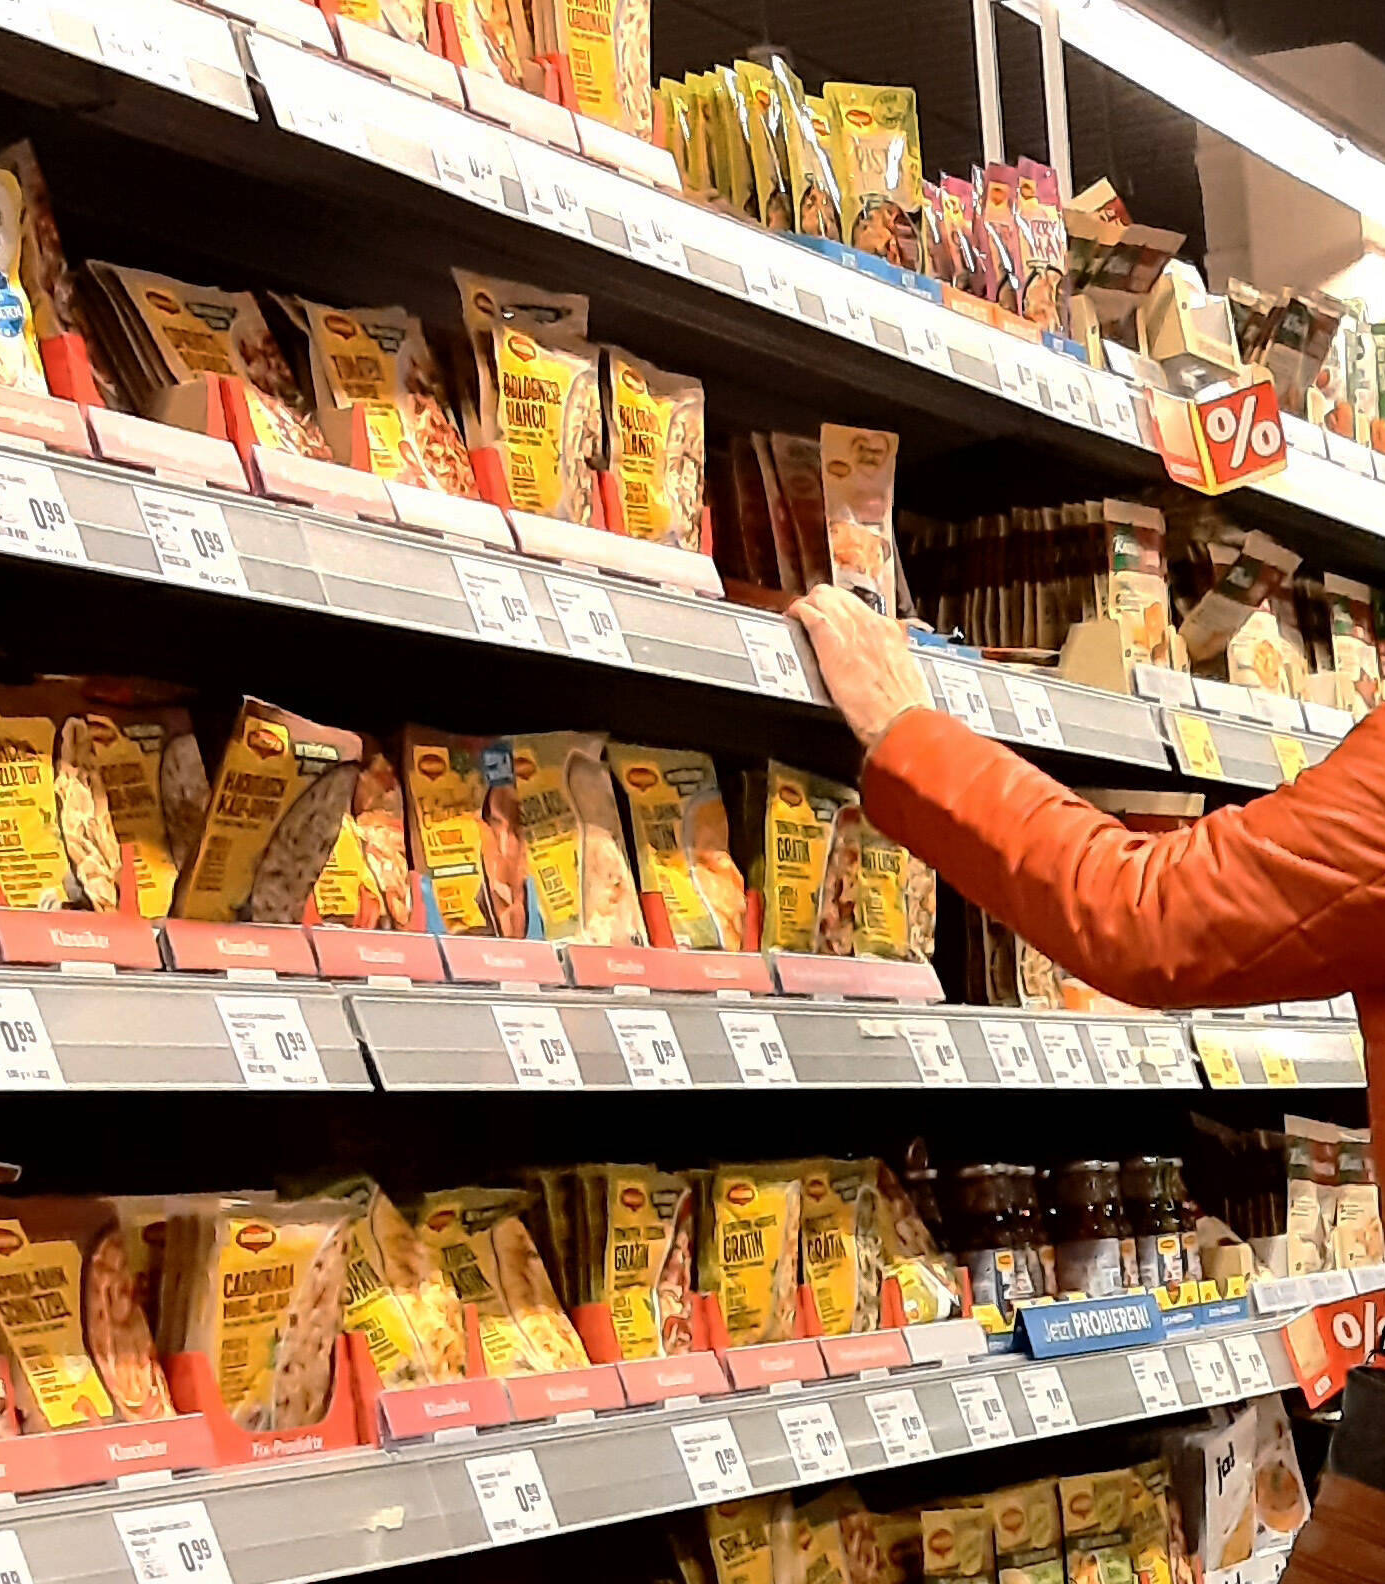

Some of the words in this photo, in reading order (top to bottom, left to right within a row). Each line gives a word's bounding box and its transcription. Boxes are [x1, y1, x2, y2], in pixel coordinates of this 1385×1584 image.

[506, 402, 545, 428] BIANCO
[29, 498, 65, 531] 0.99
[0, 1021, 36, 1052] 0.69
[723, 1229, 764, 1262] GRATIN
[1074, 1303, 1152, 1335] PROBIEREN!
[178, 1538, 211, 1572] 0.99
